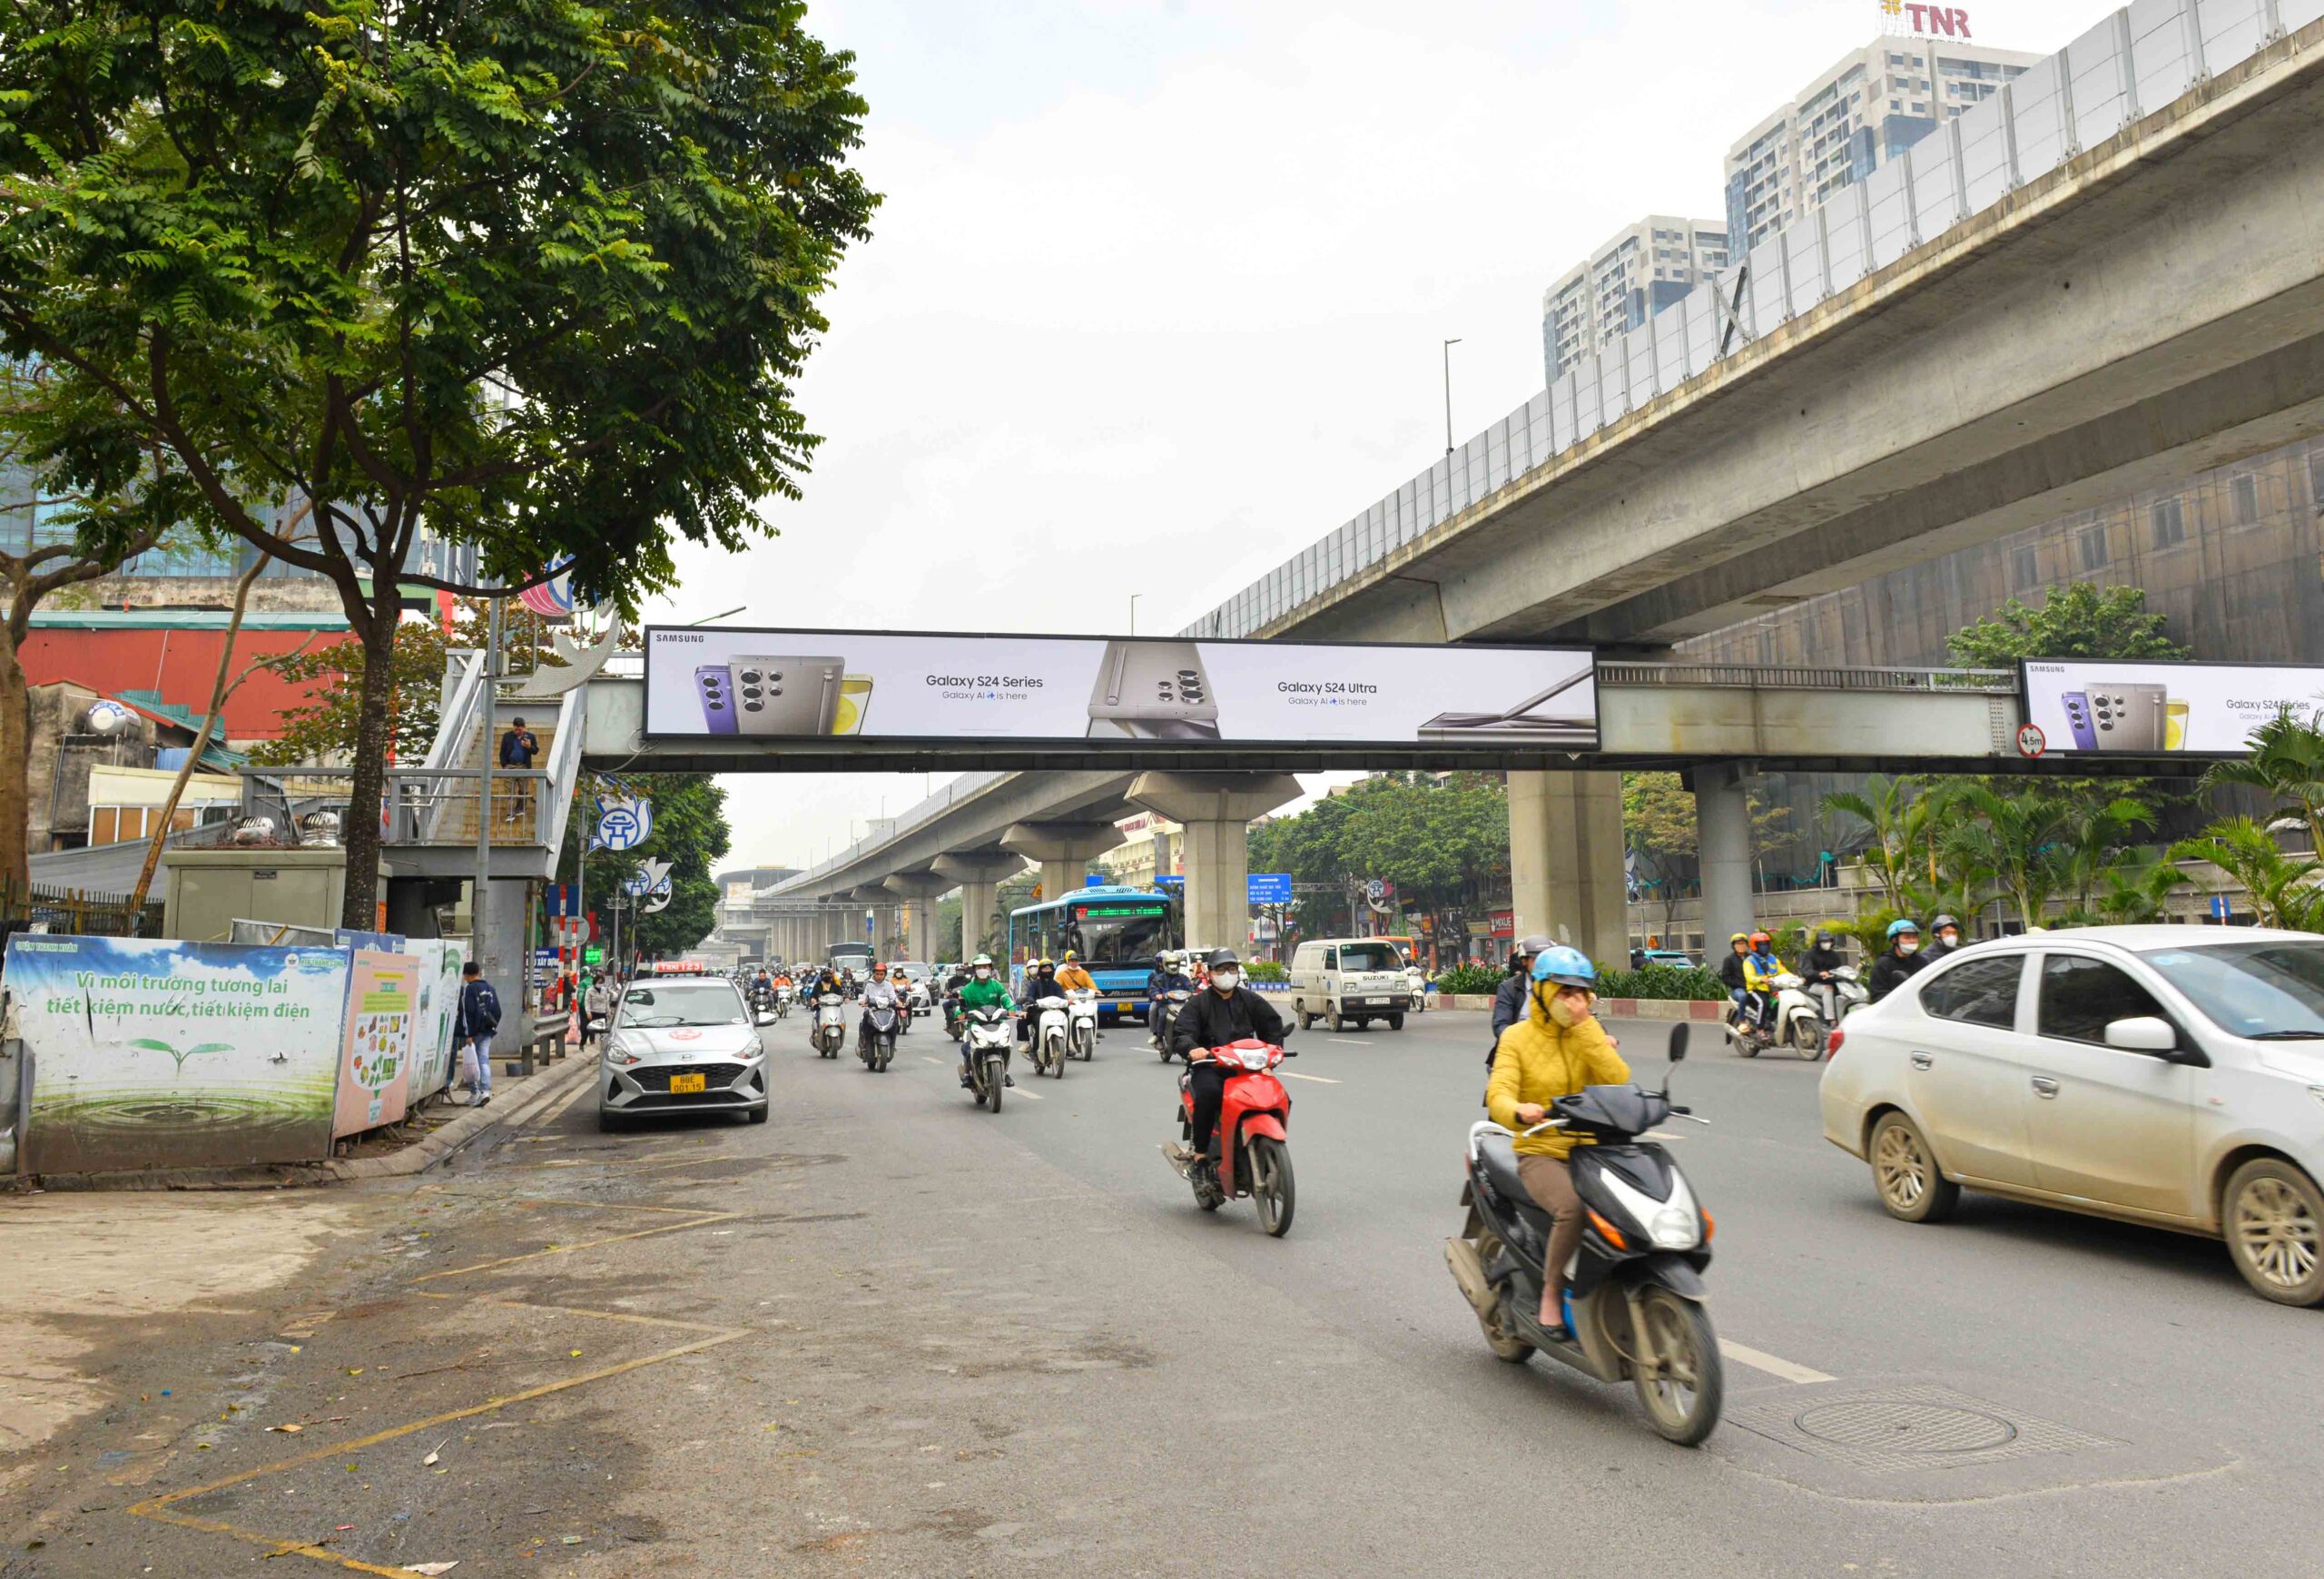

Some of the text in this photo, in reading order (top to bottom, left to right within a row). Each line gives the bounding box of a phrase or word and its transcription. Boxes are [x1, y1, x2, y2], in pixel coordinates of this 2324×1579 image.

[1905, 3, 1972, 37] TNR
[655, 634, 704, 643] SAMSUNG
[2030, 665, 2065, 673] SAMSUNG
[926, 675, 1044, 689] Galaxy S24 Series
[1277, 681, 1377, 695] Galaxy S24 Ultra
[941, 690, 1028, 701] Galaxy AI is here
[1288, 696, 1319, 706] Galaxy
[1338, 697, 1345, 706] is
[1347, 697, 1367, 706] here
[2226, 698, 2261, 711] Galaxy
[2262, 700, 2279, 710] S24
[2239, 713, 2263, 721] Galaxy
[101, 972, 137, 989] môi
[143, 974, 205, 995] trường
[211, 979, 263, 997] tương
[268, 978, 288, 993] lai
[46, 996, 81, 1014] tiết
[273, 1002, 310, 1021] điện
